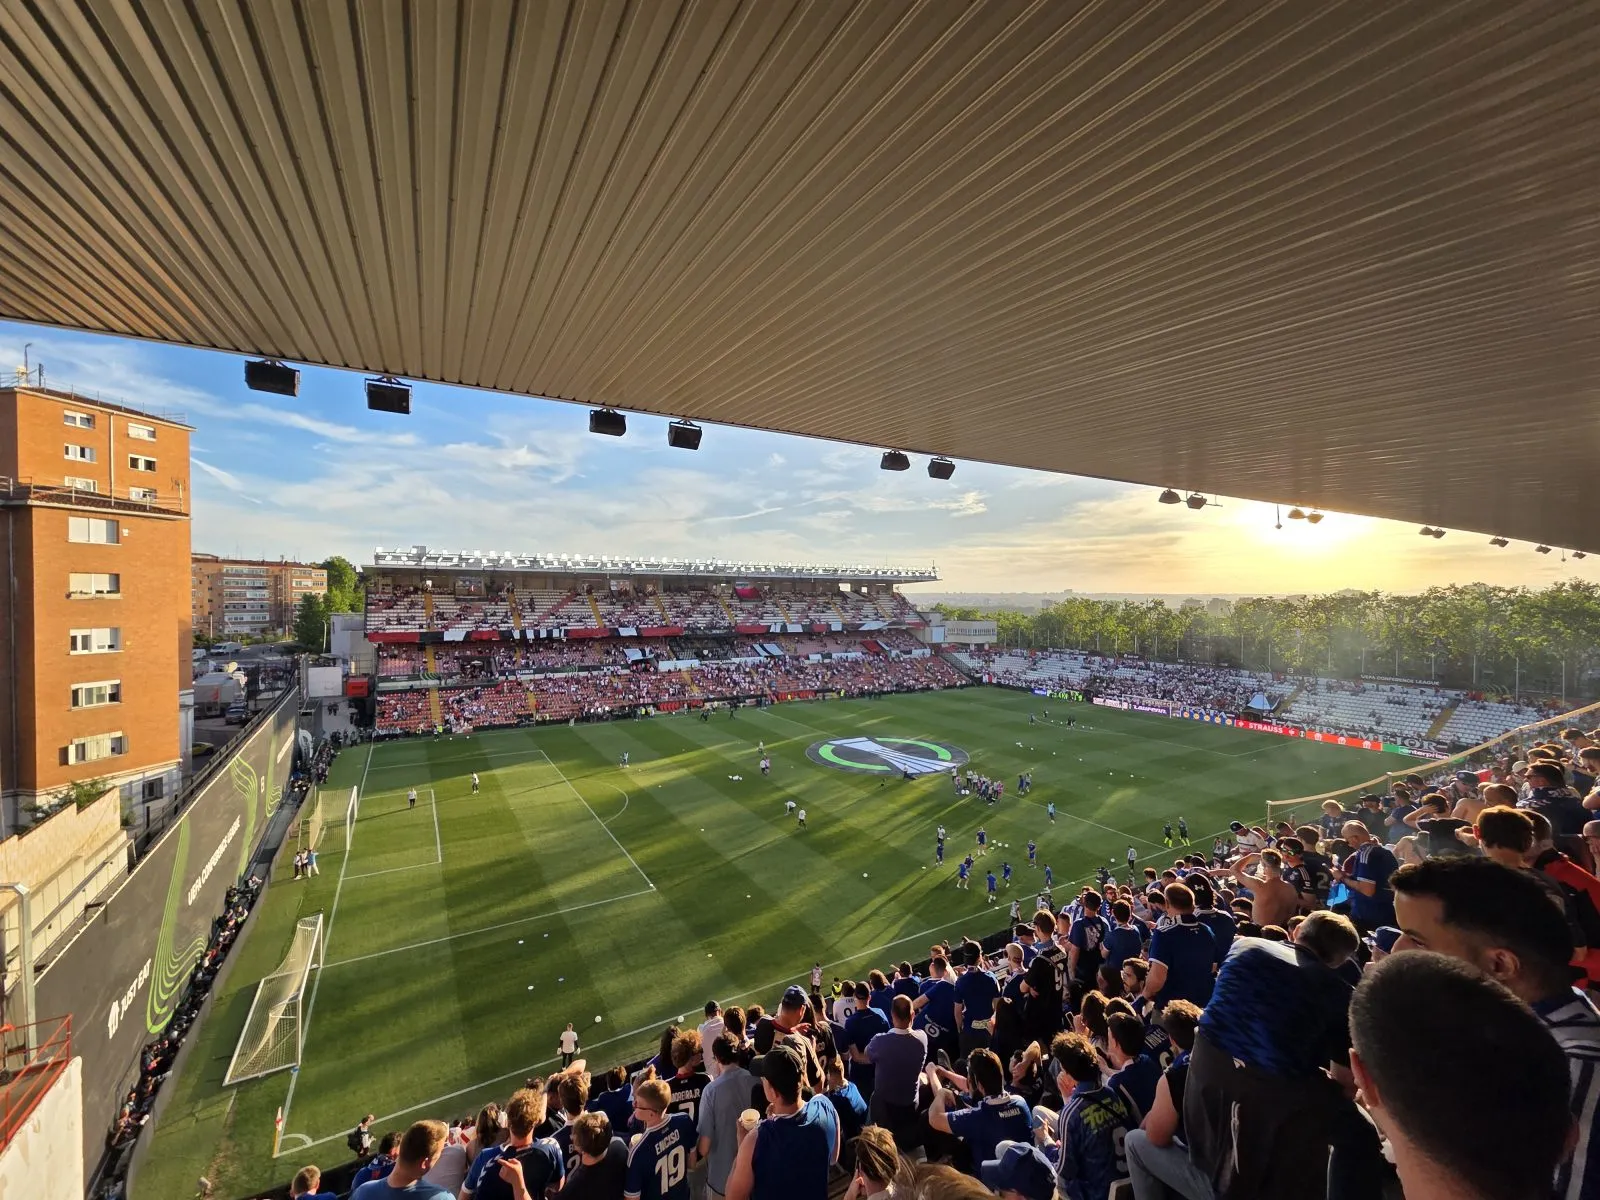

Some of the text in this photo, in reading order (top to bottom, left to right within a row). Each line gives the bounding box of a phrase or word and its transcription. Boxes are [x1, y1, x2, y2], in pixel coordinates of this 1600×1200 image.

[1376, 675, 1414, 684] CONFERENCE
[1248, 722, 1283, 734] STRAUSS
[188, 876, 202, 906] UEFA
[202, 835, 228, 884] CONFERENCE
[120, 958, 151, 1020] JUST EAT
[654, 1128, 681, 1156] ENCISO
[655, 1144, 686, 1195] 19
